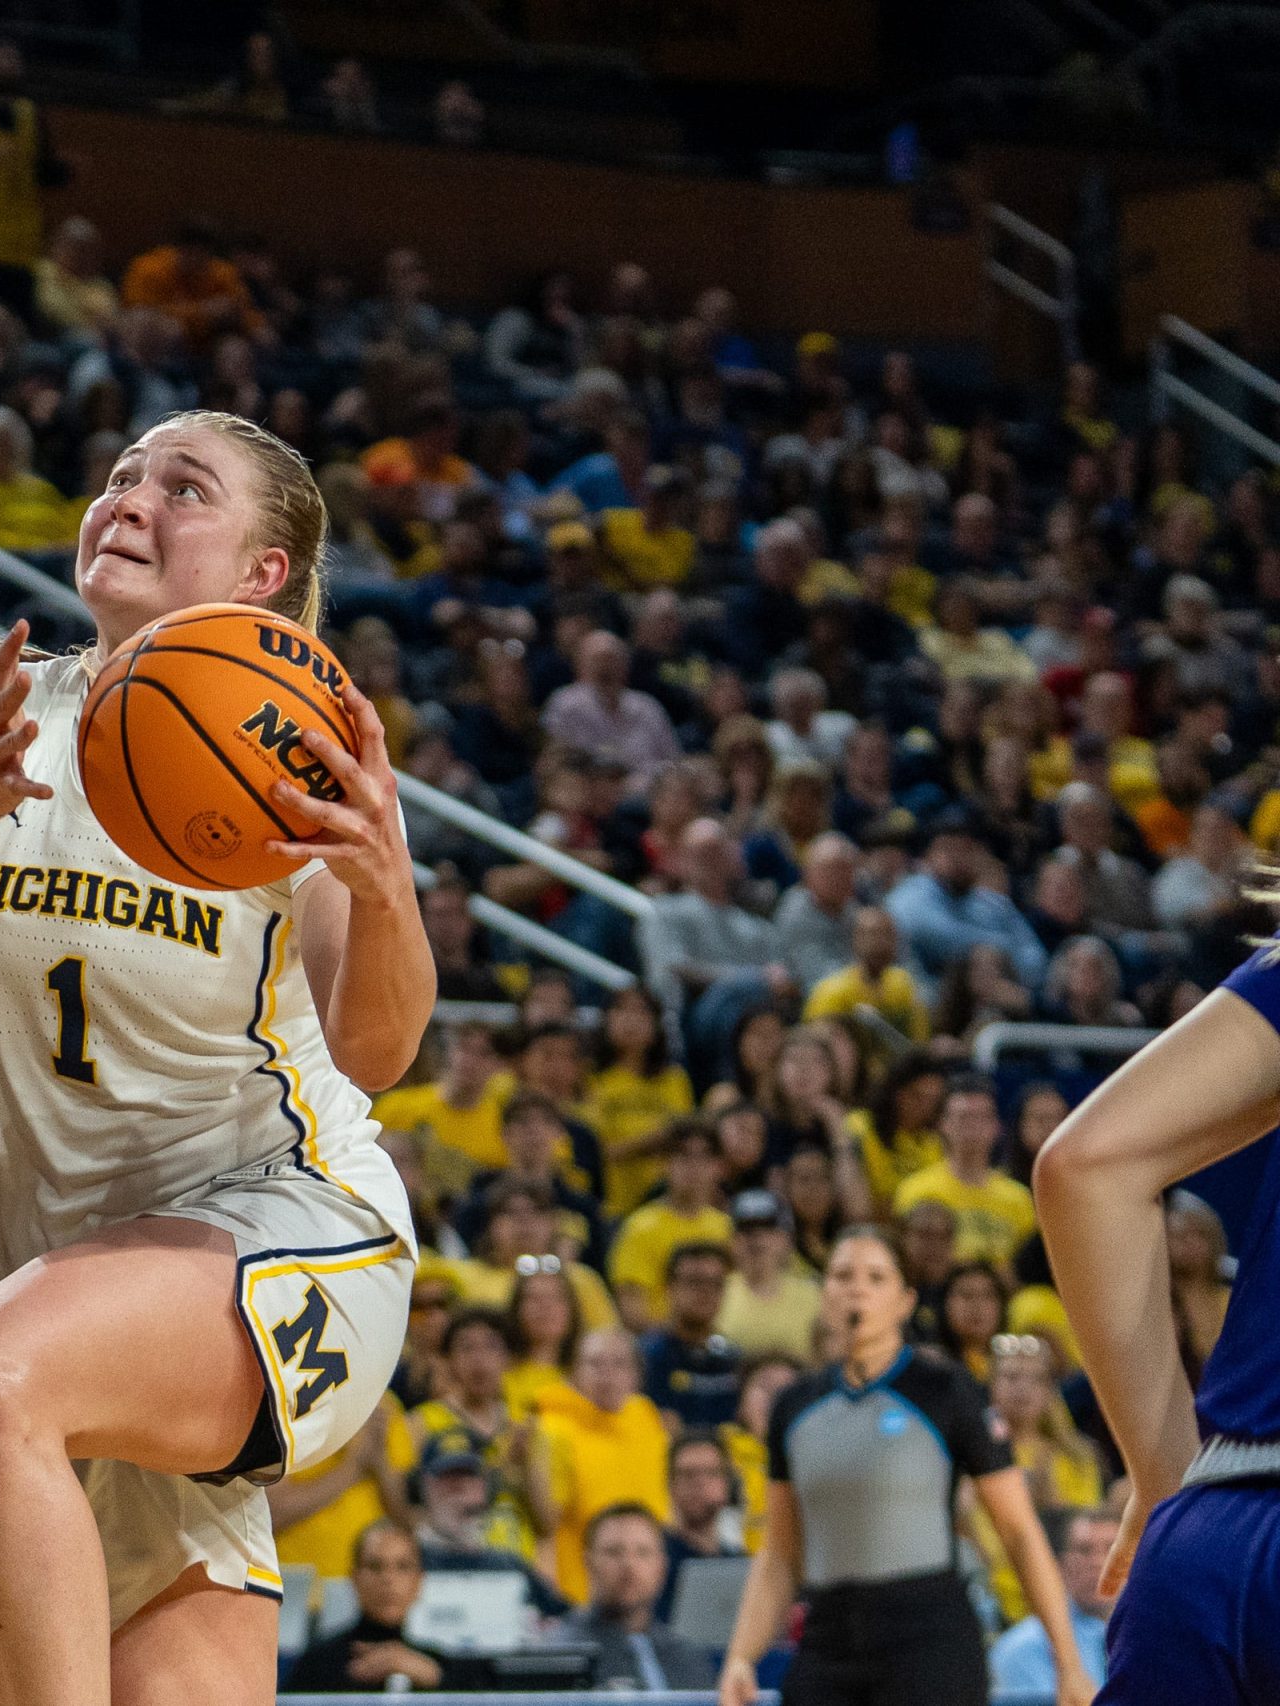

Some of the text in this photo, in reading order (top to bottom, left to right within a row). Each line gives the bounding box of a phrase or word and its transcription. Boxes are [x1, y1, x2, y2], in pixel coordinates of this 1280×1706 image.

[232, 730, 277, 774] OFFICIAL
[45, 954, 98, 1086] 1
[269, 1282, 350, 1422] M
